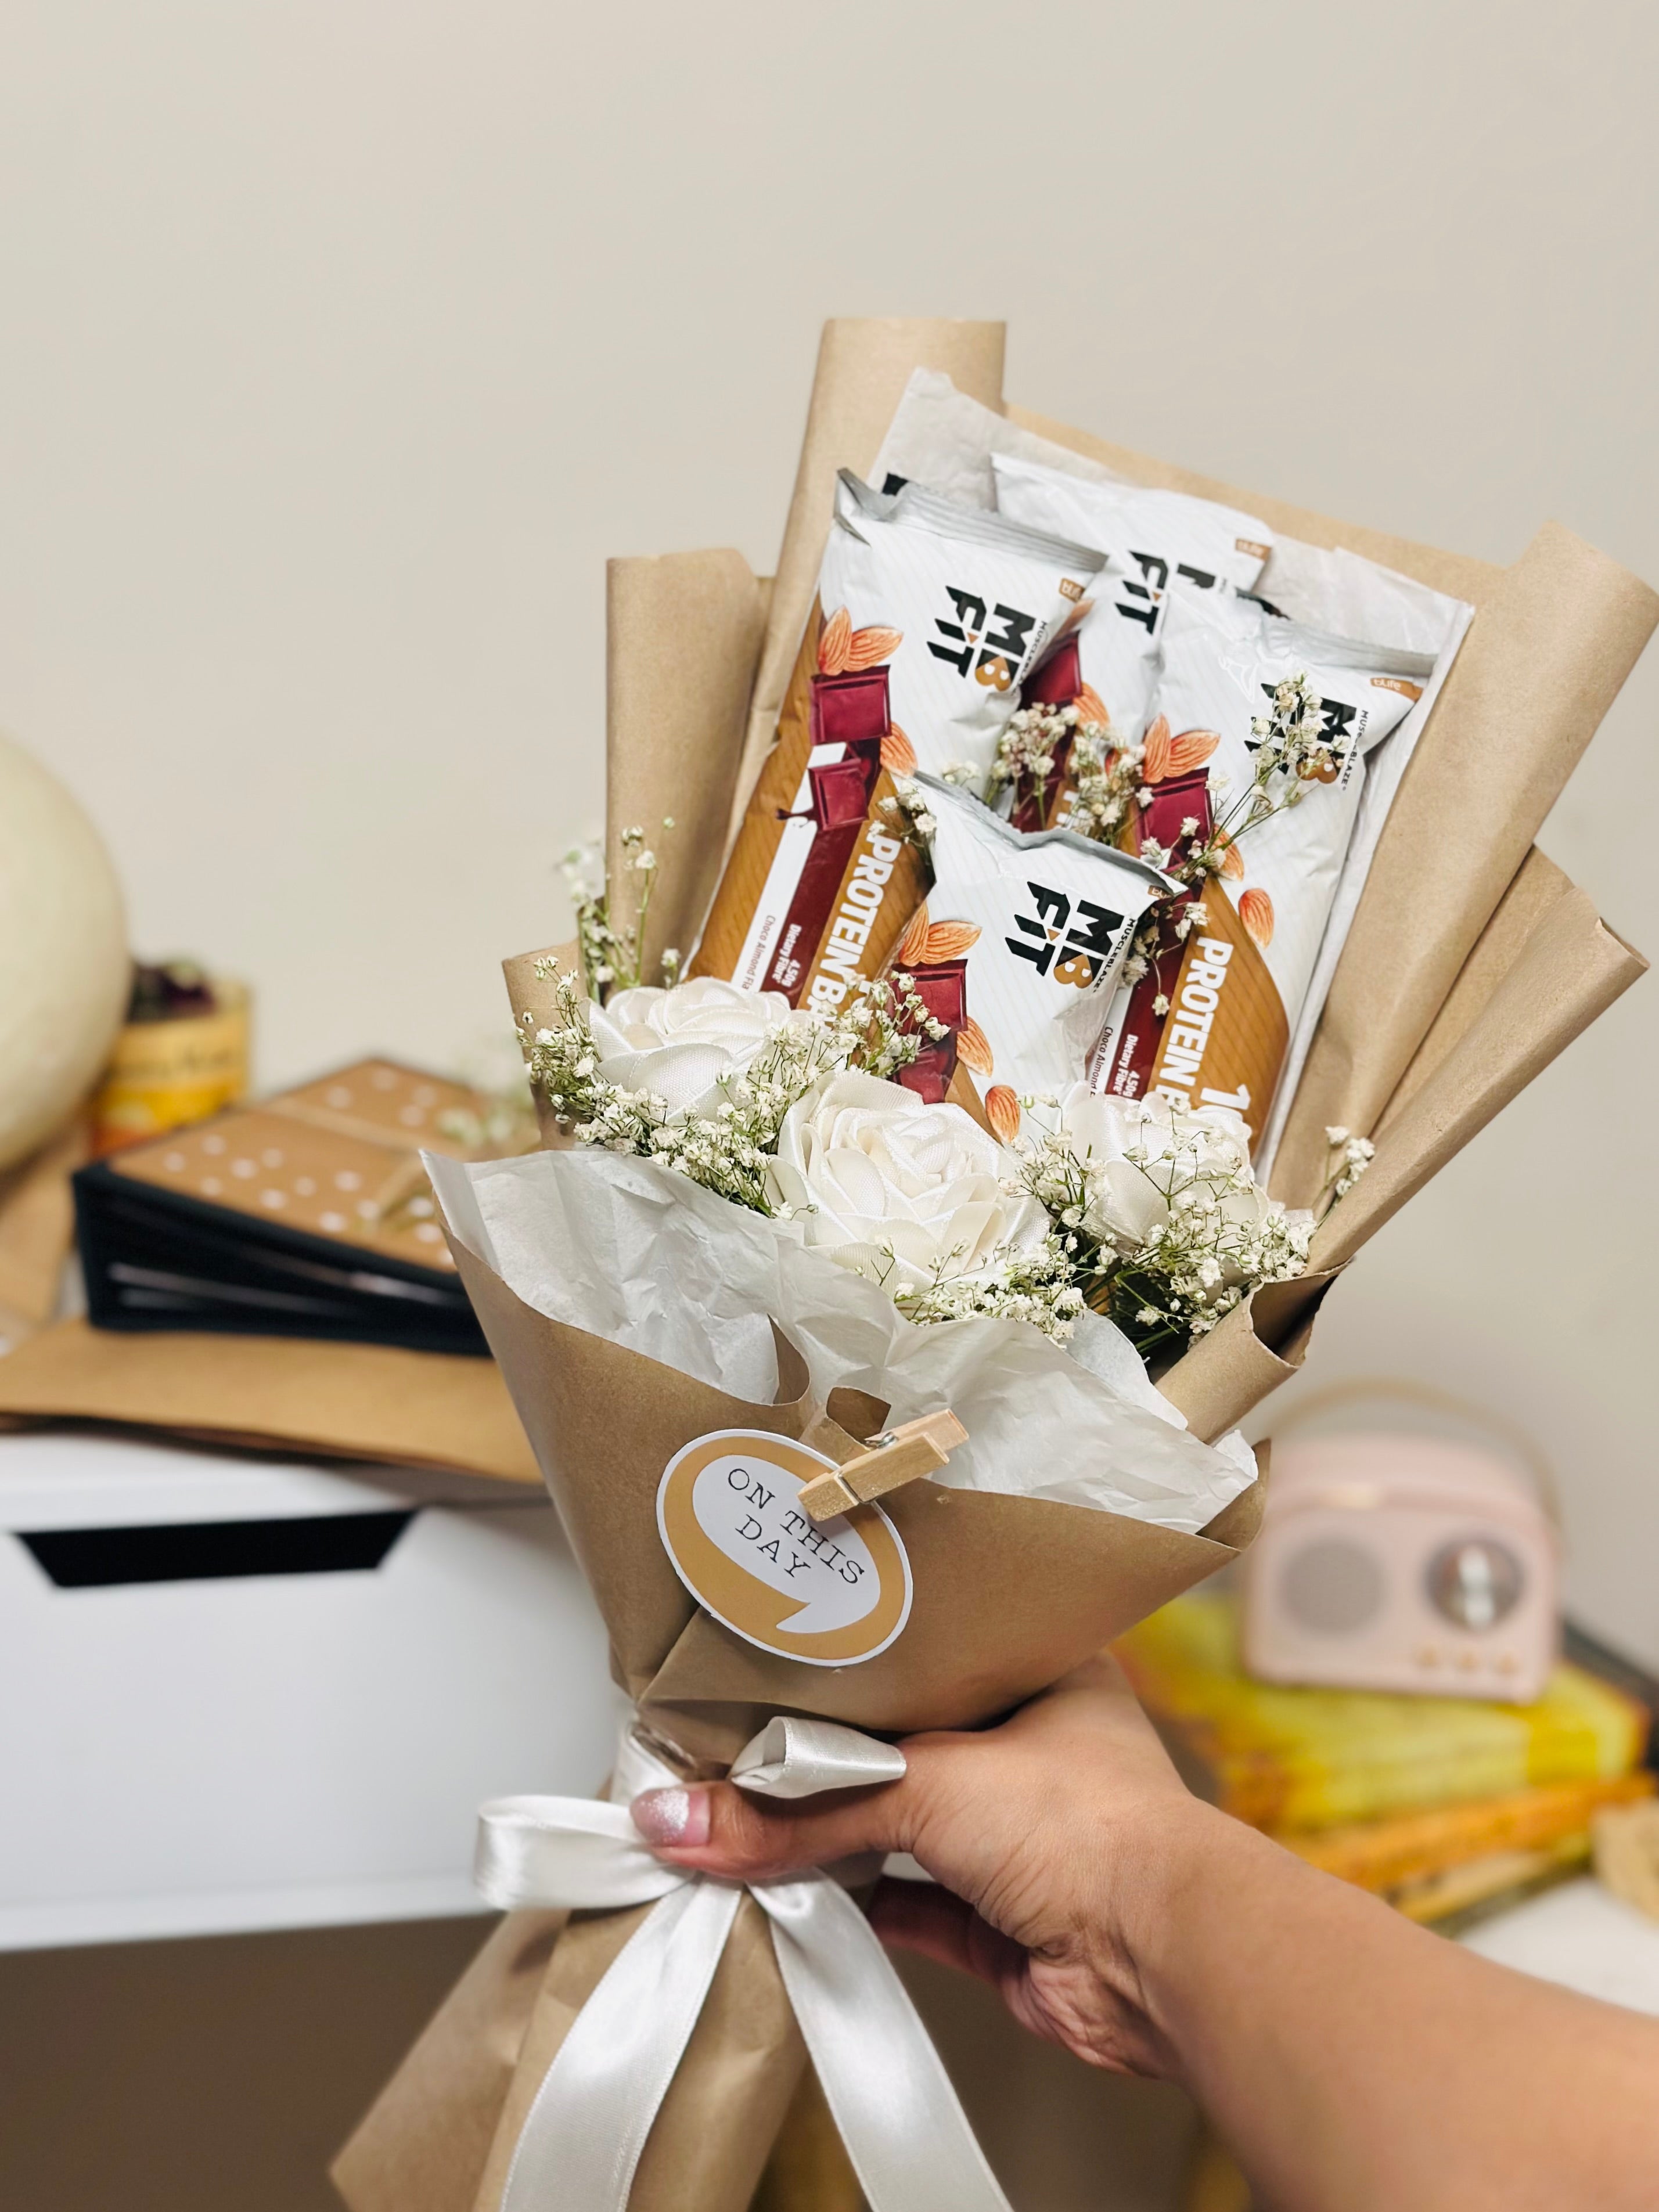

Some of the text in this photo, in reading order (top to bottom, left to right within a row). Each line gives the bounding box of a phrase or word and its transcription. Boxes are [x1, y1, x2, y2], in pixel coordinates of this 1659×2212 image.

[927, 585, 987, 678] FIT
[1115, 550, 1168, 636] FIT
[974, 602, 1036, 692] MB
[760, 915, 776, 941] Choco
[779, 923, 802, 957] Dietary
[819, 830, 902, 983] PROTEIN
[1005, 881, 1071, 977] FIT
[1053, 899, 1125, 989] MB
[747, 942, 766, 977] Almond
[1099, 1026, 1113, 1053] Choco
[1118, 1034, 1139, 1068] Dietary
[1159, 936, 1234, 1086] PROTEIN
[728, 1468, 865, 1584] ON THIS
[735, 1514, 811, 1578] DAY
